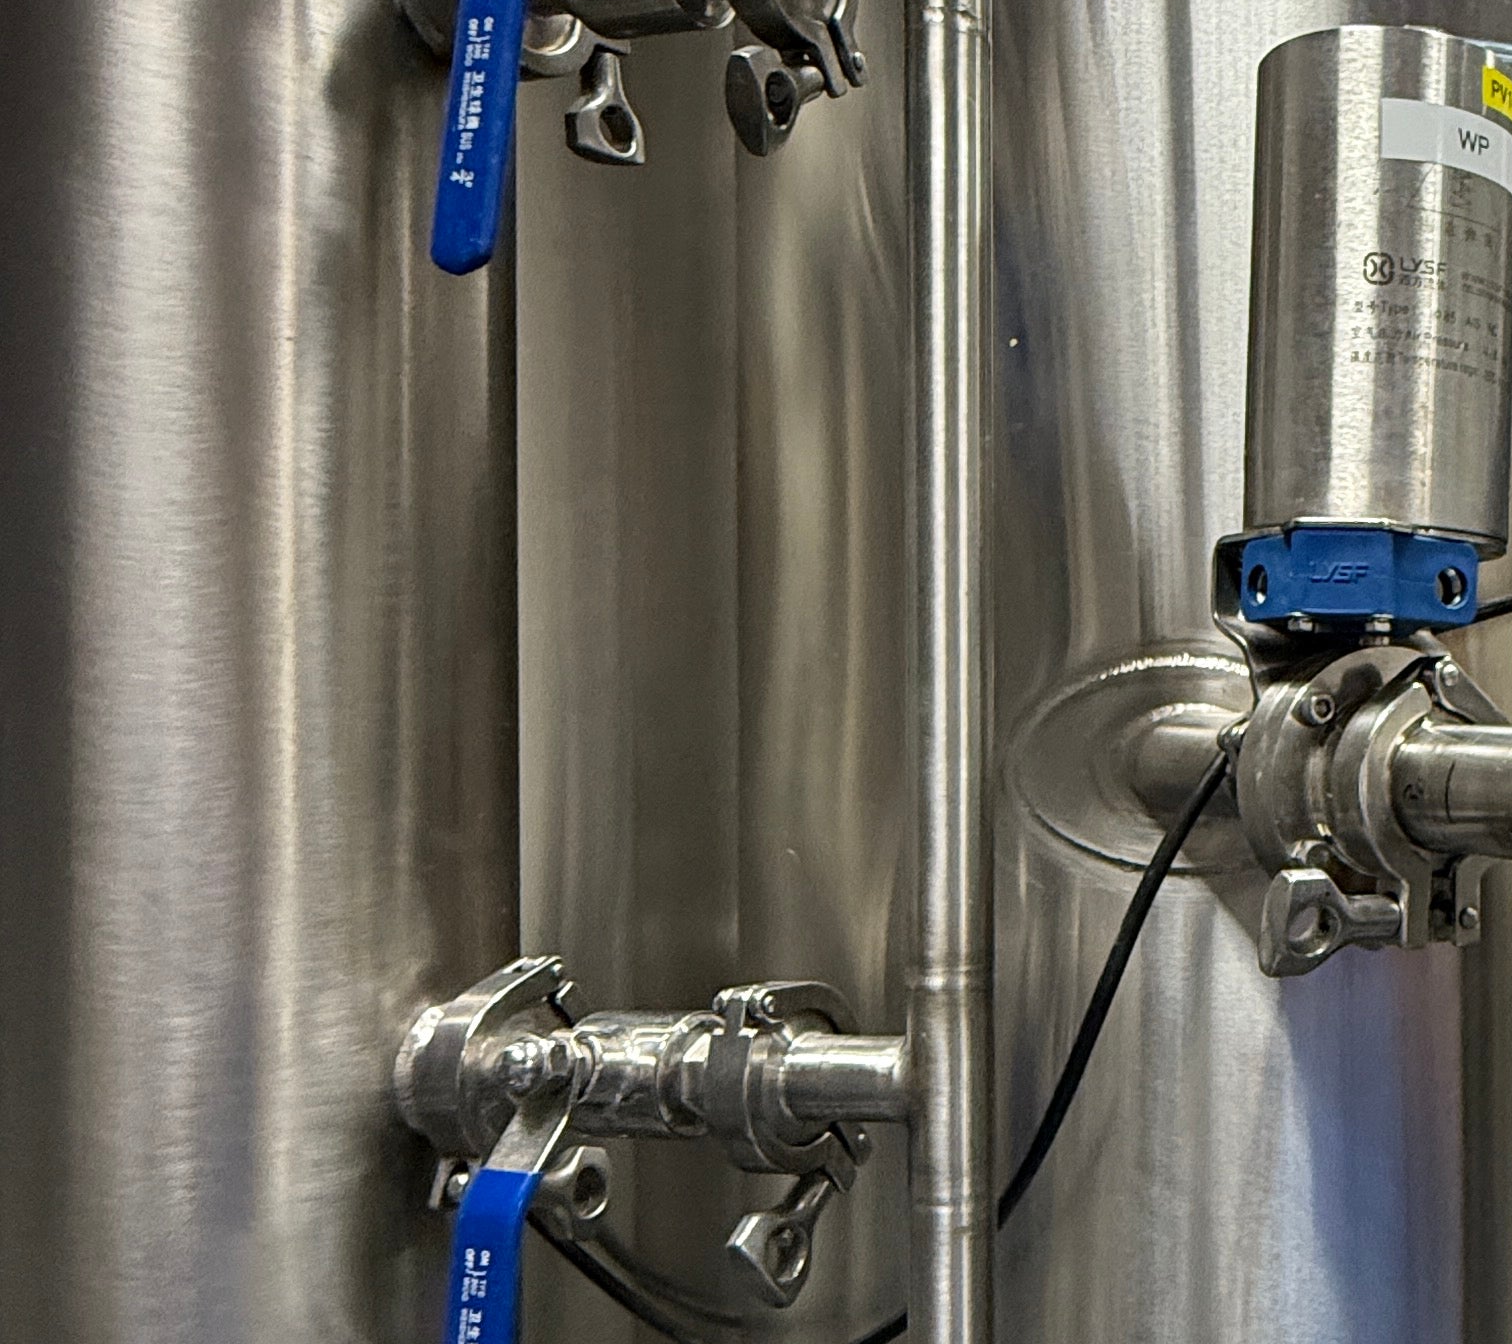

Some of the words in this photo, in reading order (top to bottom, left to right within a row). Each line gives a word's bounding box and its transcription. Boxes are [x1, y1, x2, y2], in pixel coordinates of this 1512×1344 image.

[1457, 127, 1490, 155] WP
[1400, 257, 1447, 276] LYSF
[1309, 560, 1370, 584] LYSF
